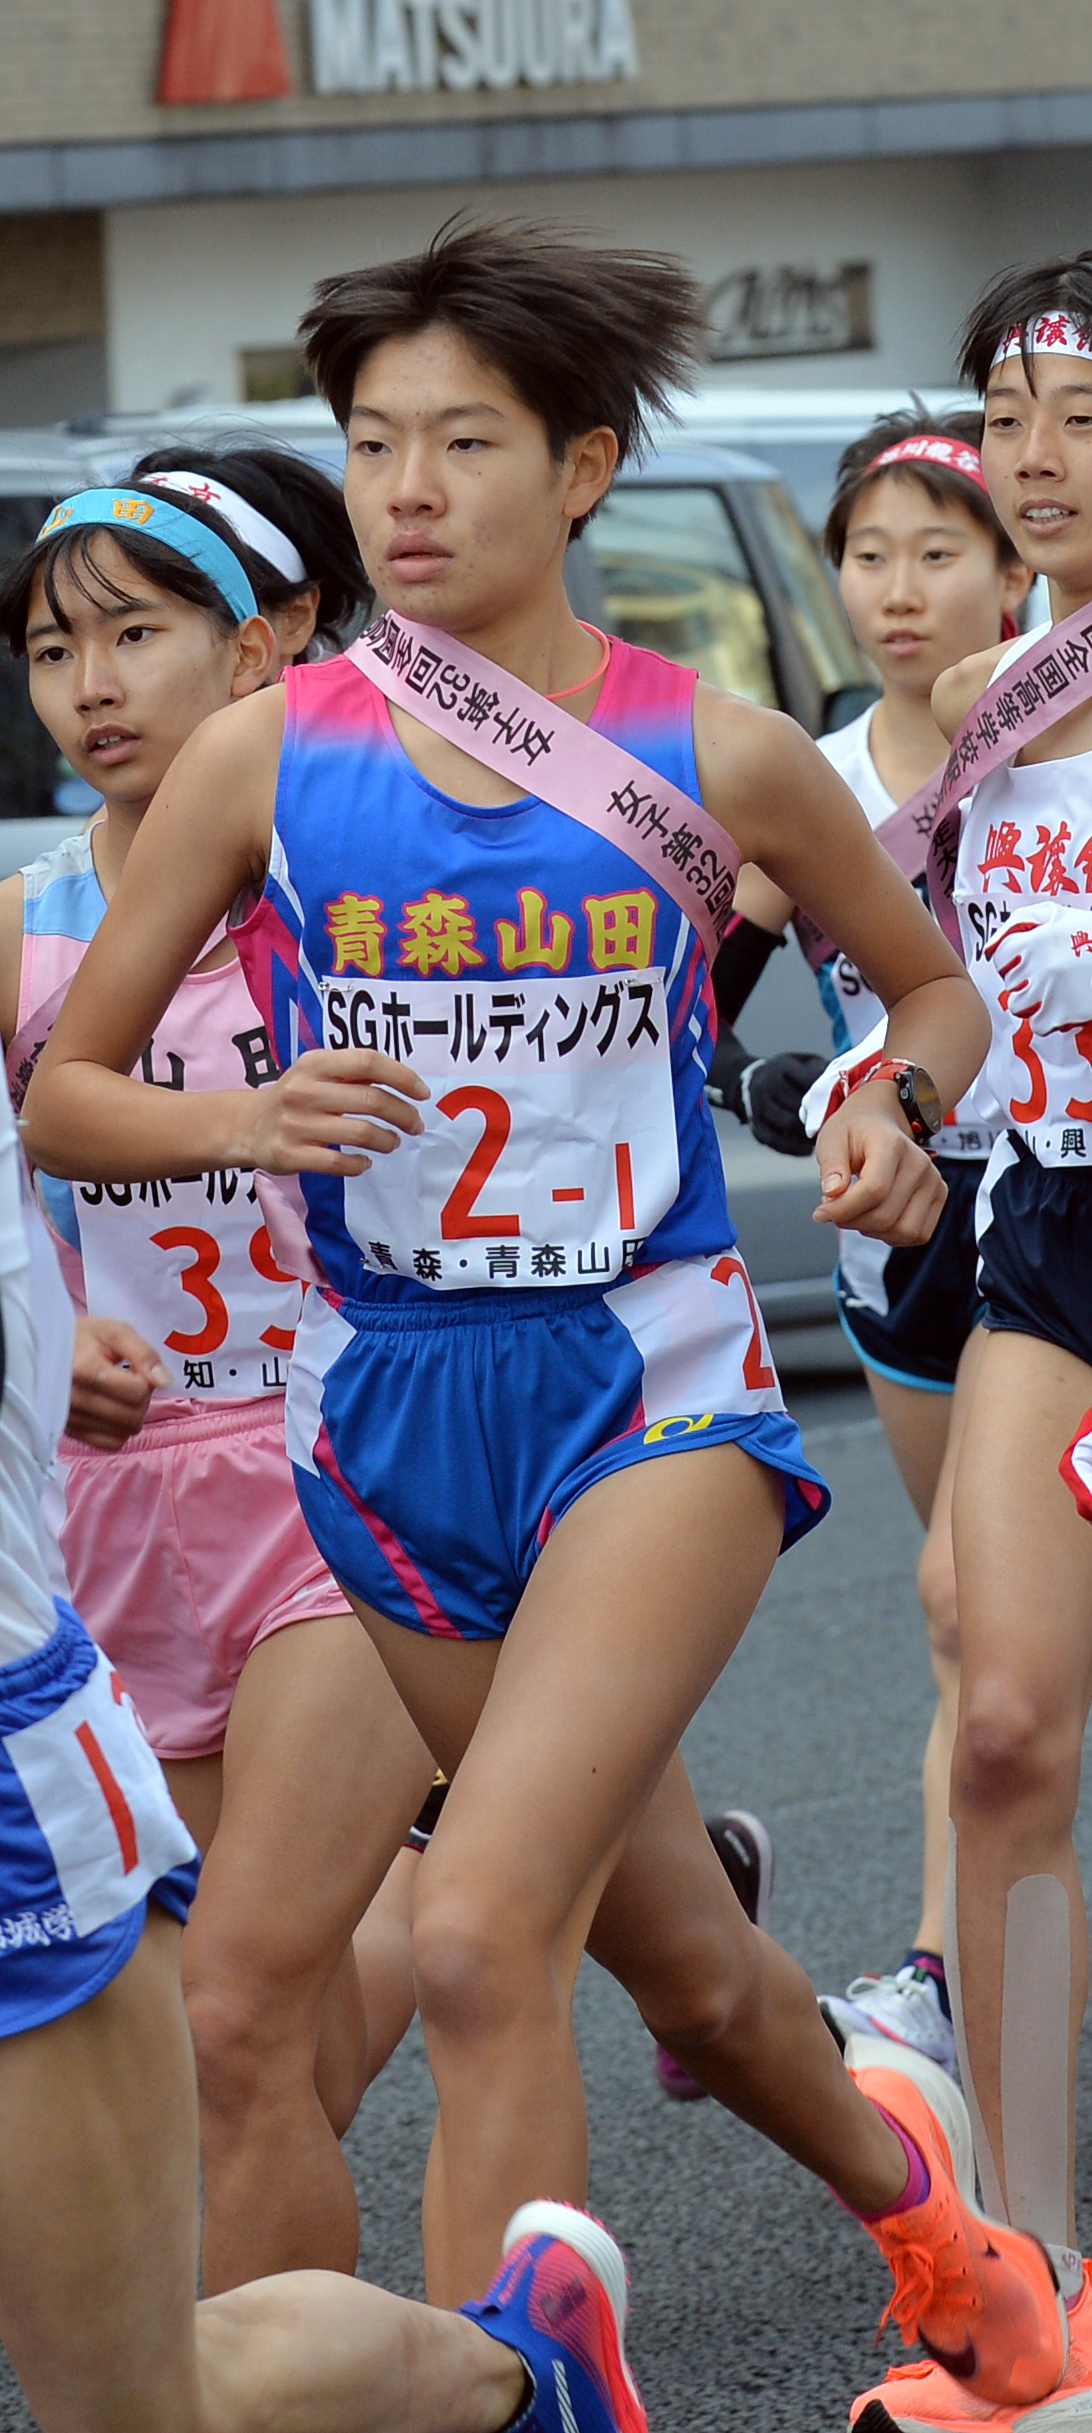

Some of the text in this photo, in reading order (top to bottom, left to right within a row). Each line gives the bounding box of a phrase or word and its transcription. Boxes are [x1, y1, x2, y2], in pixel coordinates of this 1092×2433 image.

[310, 0, 639, 93] MATSUURA
[325, 887, 658, 977] 青森山田
[327, 981, 660, 1064] SGホールディングス
[435, 1085, 636, 1240] 2-1
[710, 1256, 776, 1391] 2
